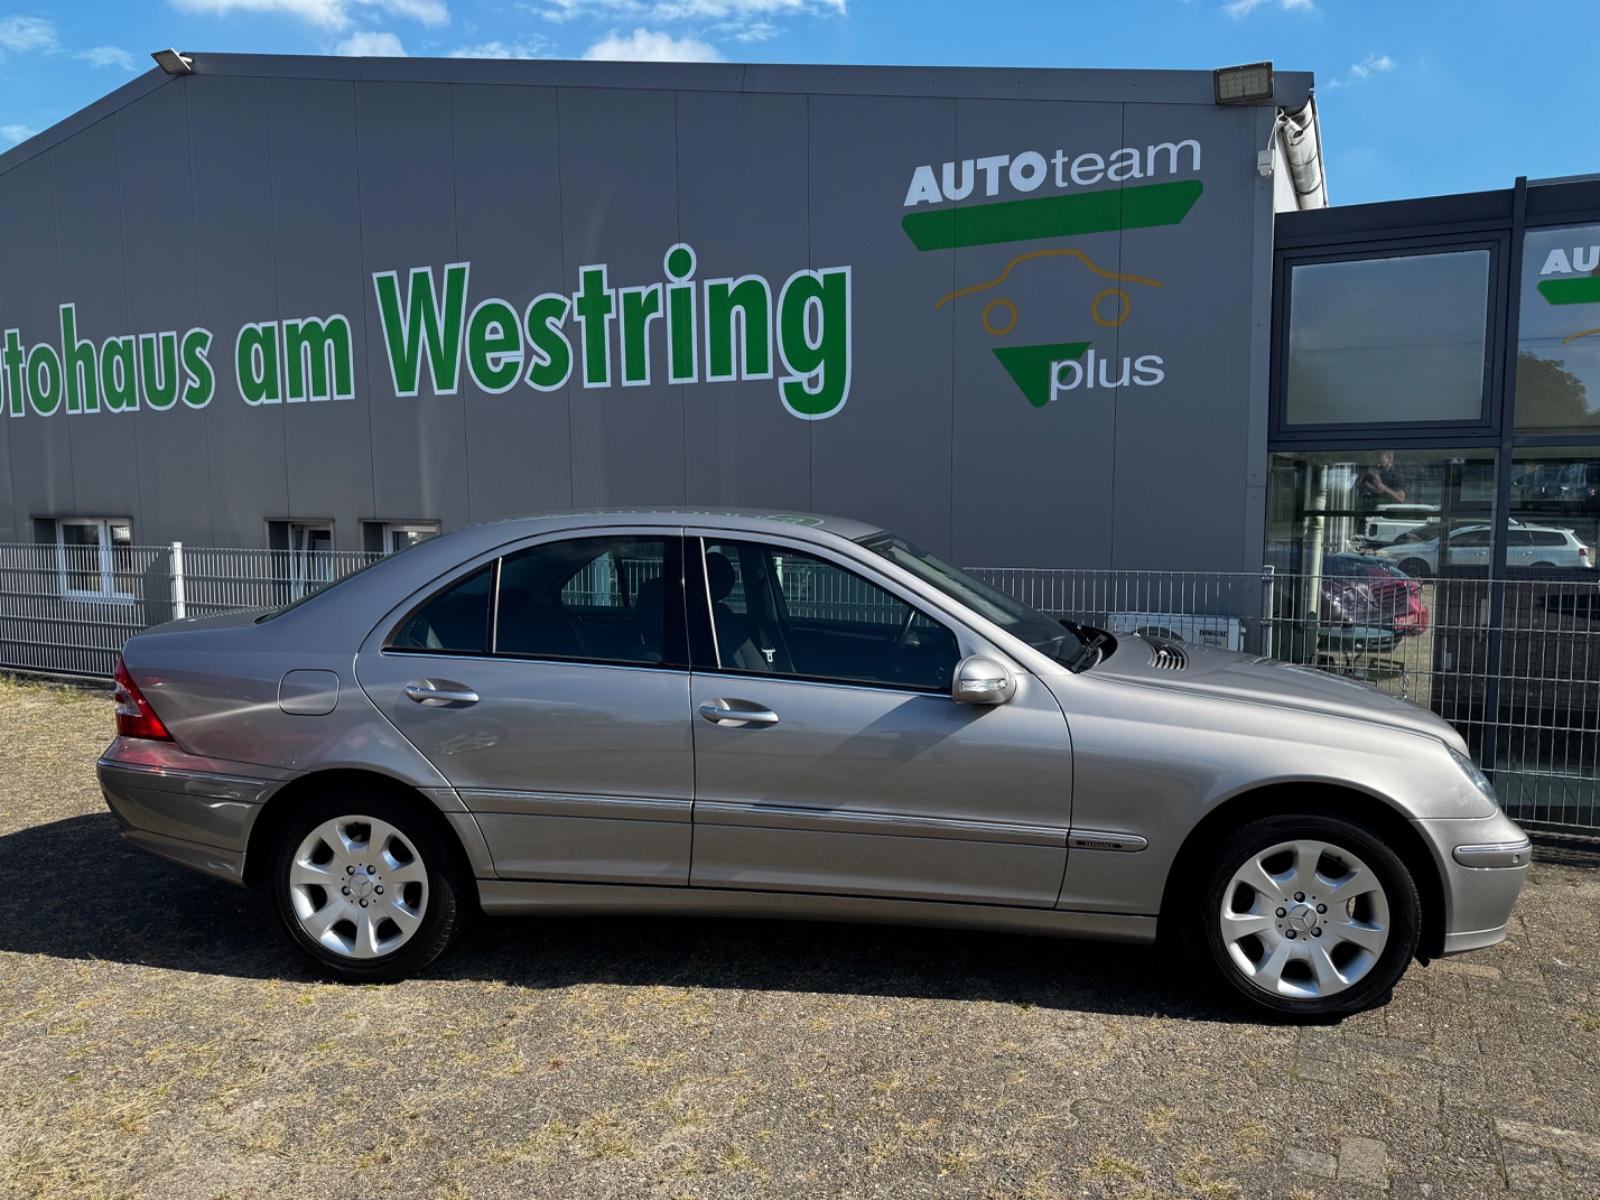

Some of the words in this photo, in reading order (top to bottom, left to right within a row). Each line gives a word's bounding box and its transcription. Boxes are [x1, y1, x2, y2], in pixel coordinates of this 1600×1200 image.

[904, 139, 1201, 206] AUTOteam
[0, 303, 215, 417] tohaus
[235, 314, 355, 406] am
[372, 243, 852, 420] Westring
[1050, 349, 1165, 401] plus
